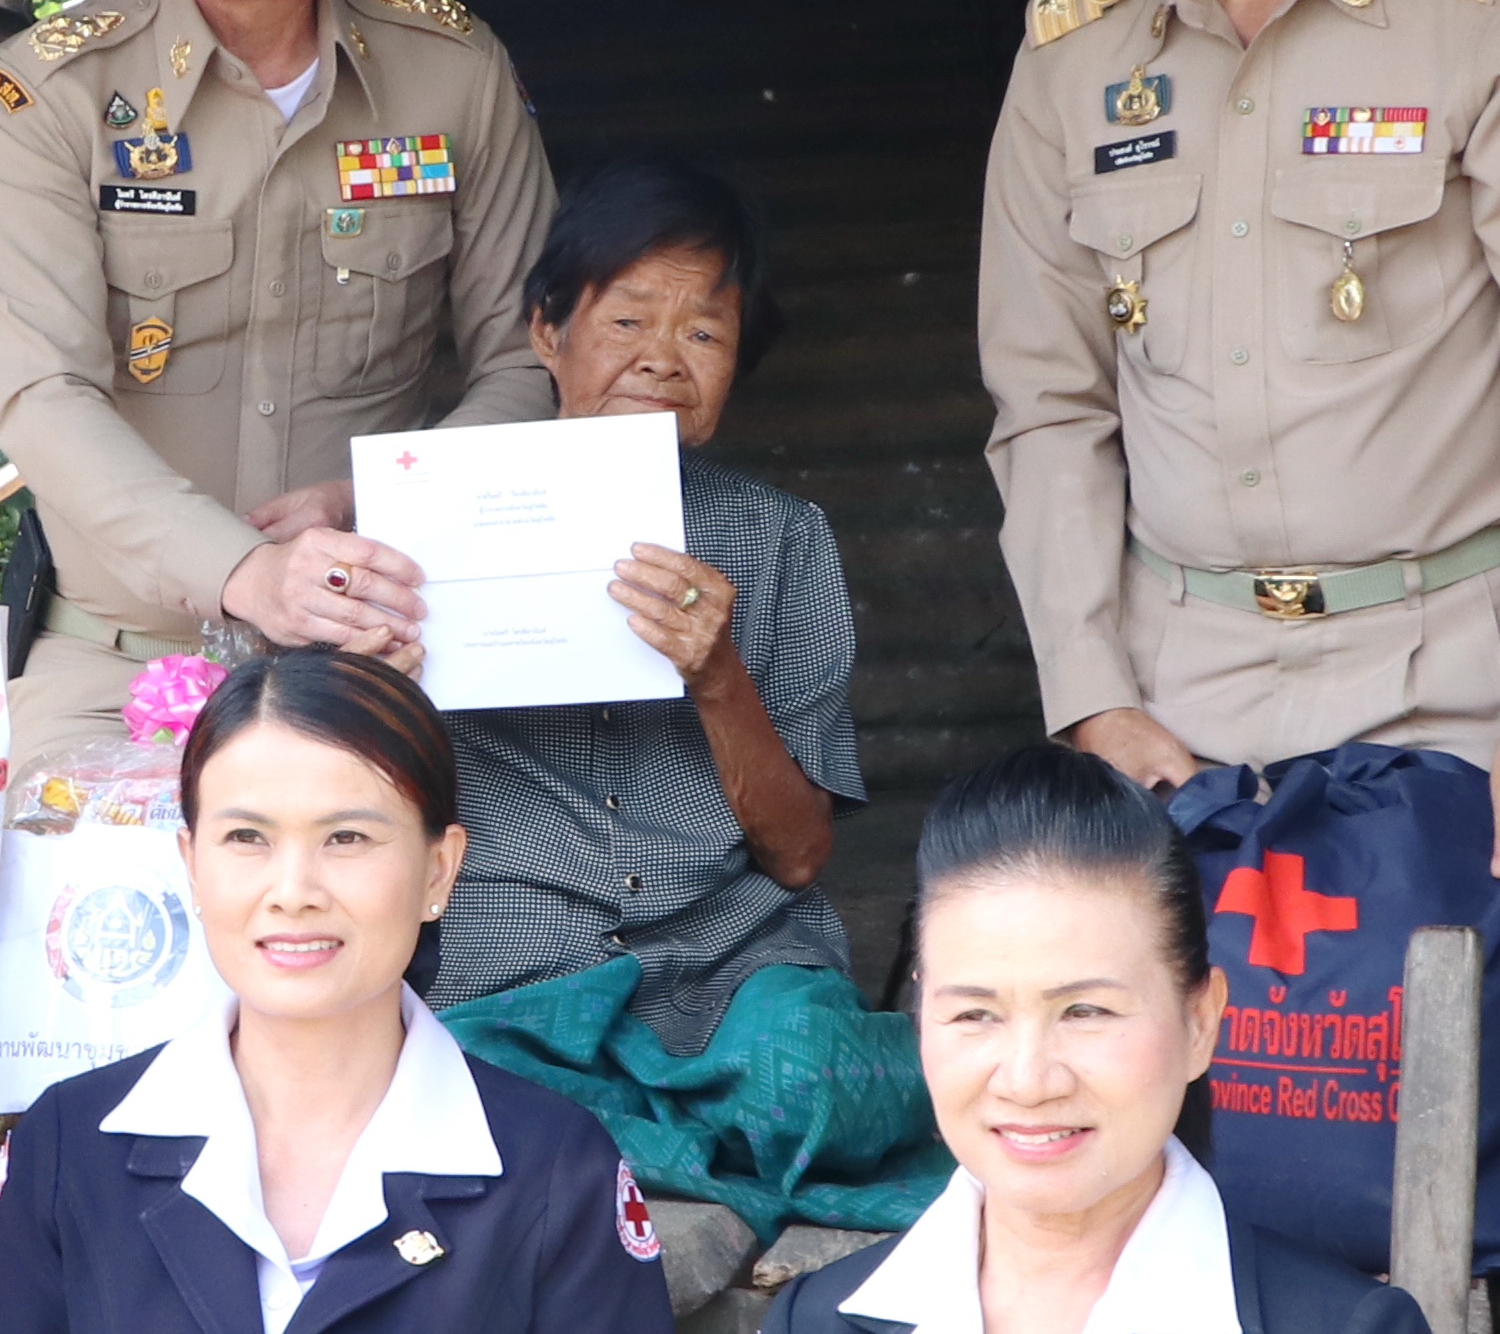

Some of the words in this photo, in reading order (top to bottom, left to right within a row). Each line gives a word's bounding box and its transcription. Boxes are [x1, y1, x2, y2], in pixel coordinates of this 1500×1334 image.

[1221, 985, 1403, 1083] าดจังหวัดสุโ
[1277, 1076, 1319, 1118] Red
[1322, 1079, 1383, 1123] Cross
